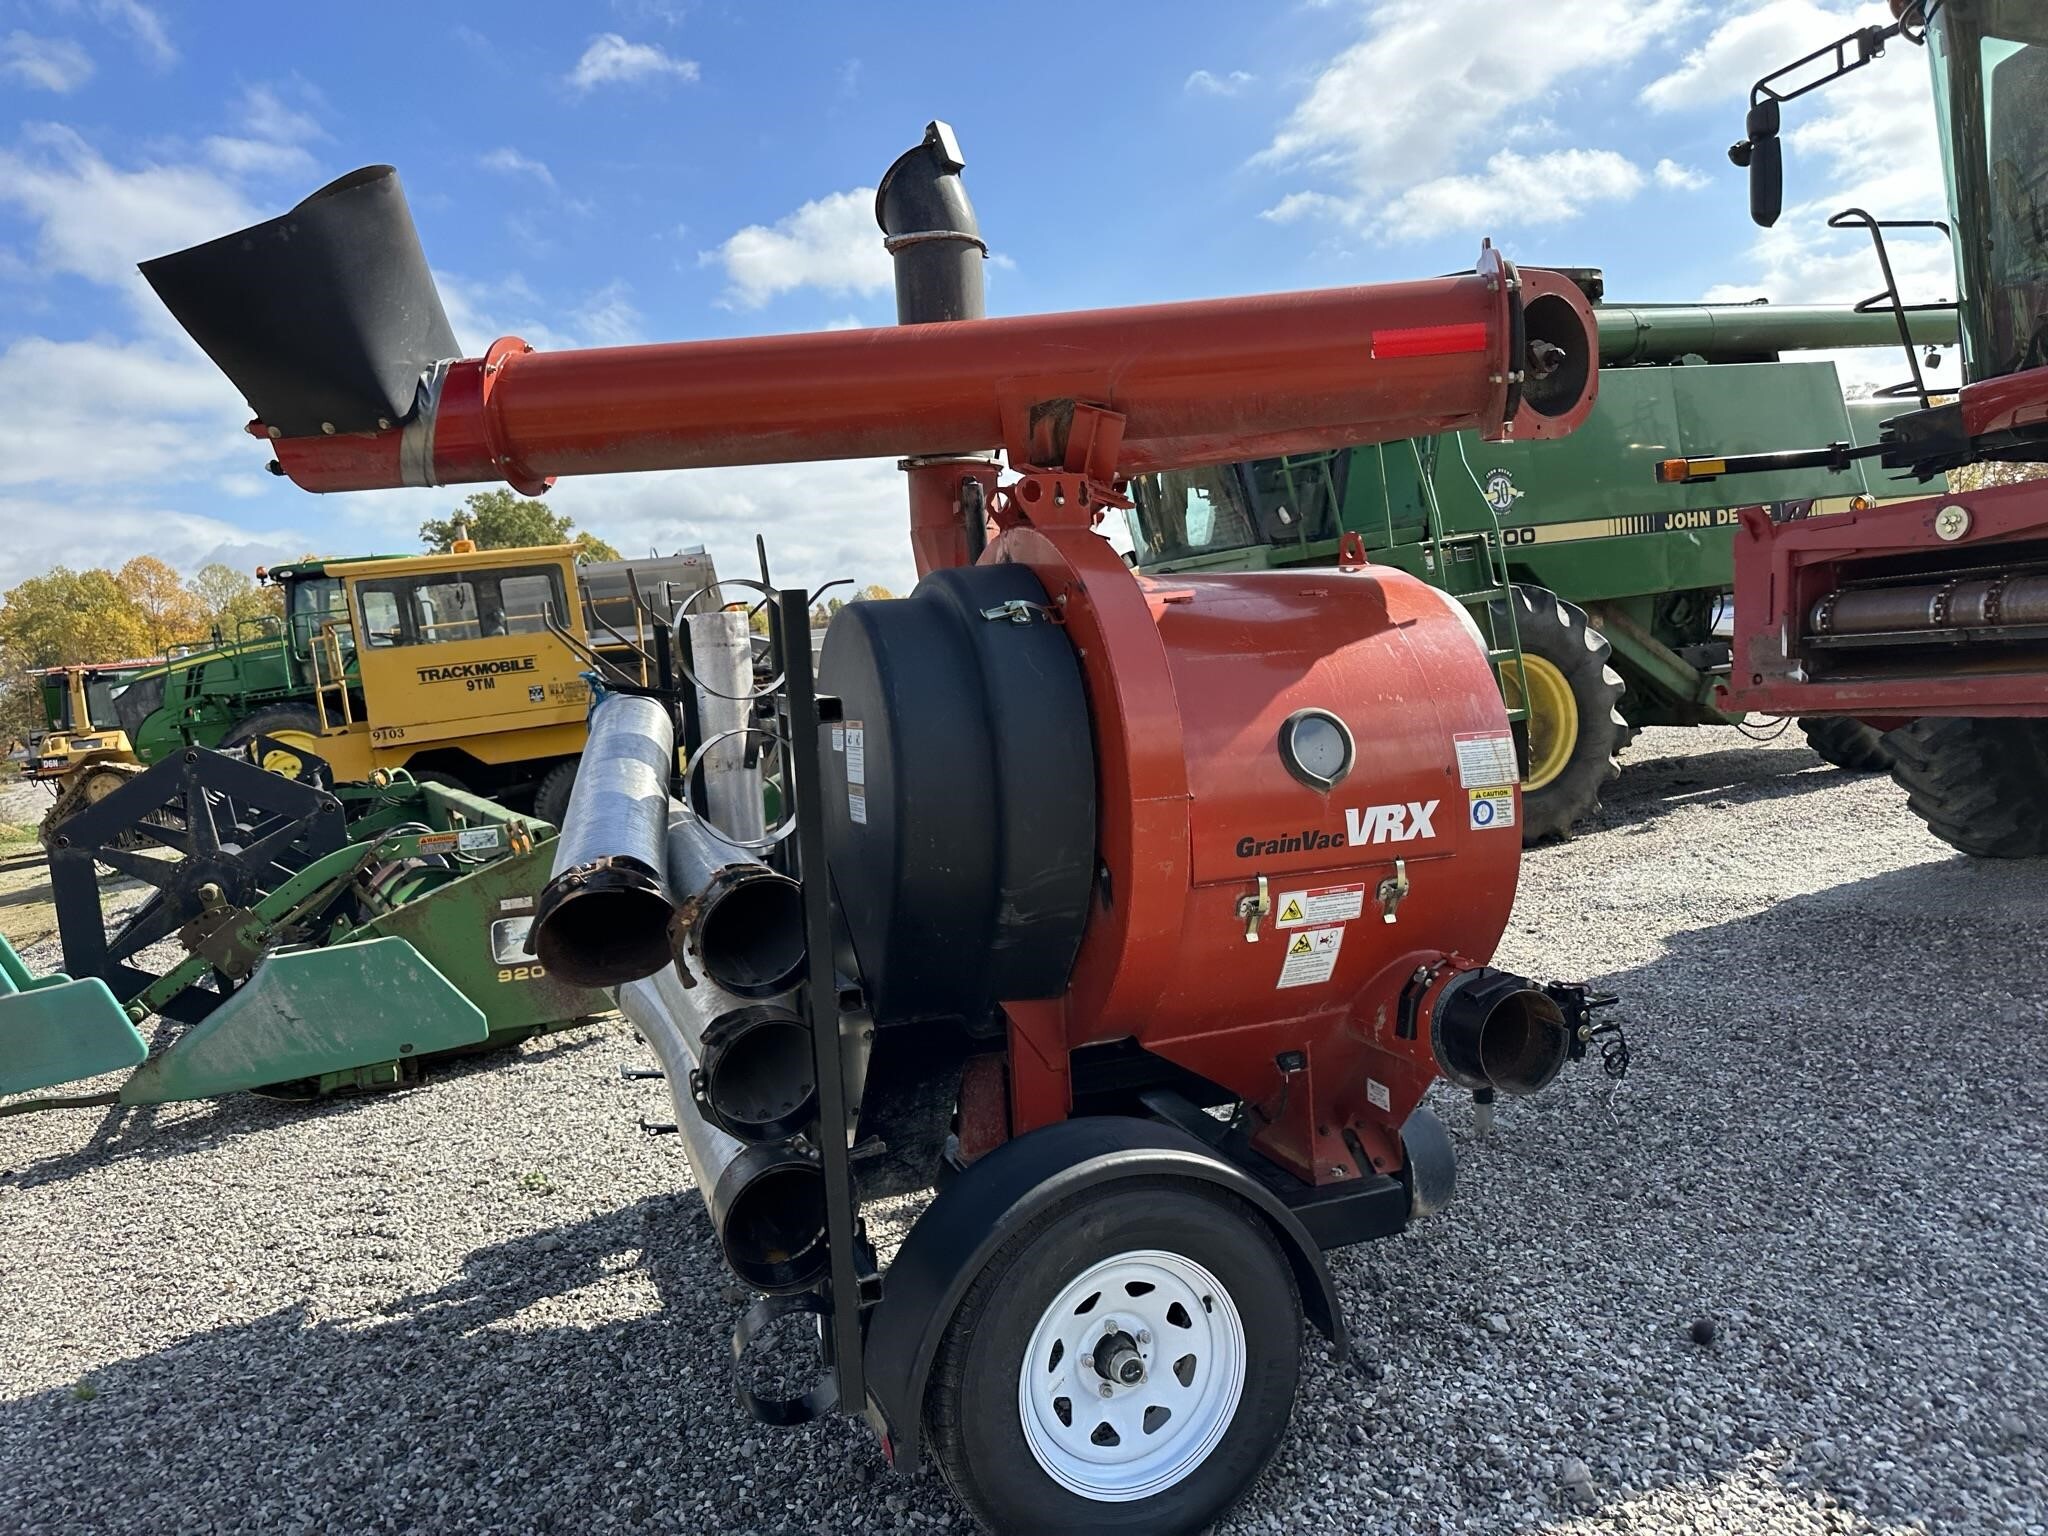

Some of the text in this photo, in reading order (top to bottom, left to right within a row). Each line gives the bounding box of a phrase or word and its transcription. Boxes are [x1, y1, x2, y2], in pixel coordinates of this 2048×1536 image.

[1493, 480, 1509, 505] 50
[1664, 504, 1772, 530] JOHN DEE
[417, 658, 535, 682] TRACKMOBILE
[466, 677, 495, 691] 9TM
[372, 728, 405, 741] 9103
[1482, 789, 1508, 798] CAUTION
[1236, 800, 1440, 858] GrainVac VRX
[427, 834, 457, 843] WARNING
[498, 965, 546, 983] 920
